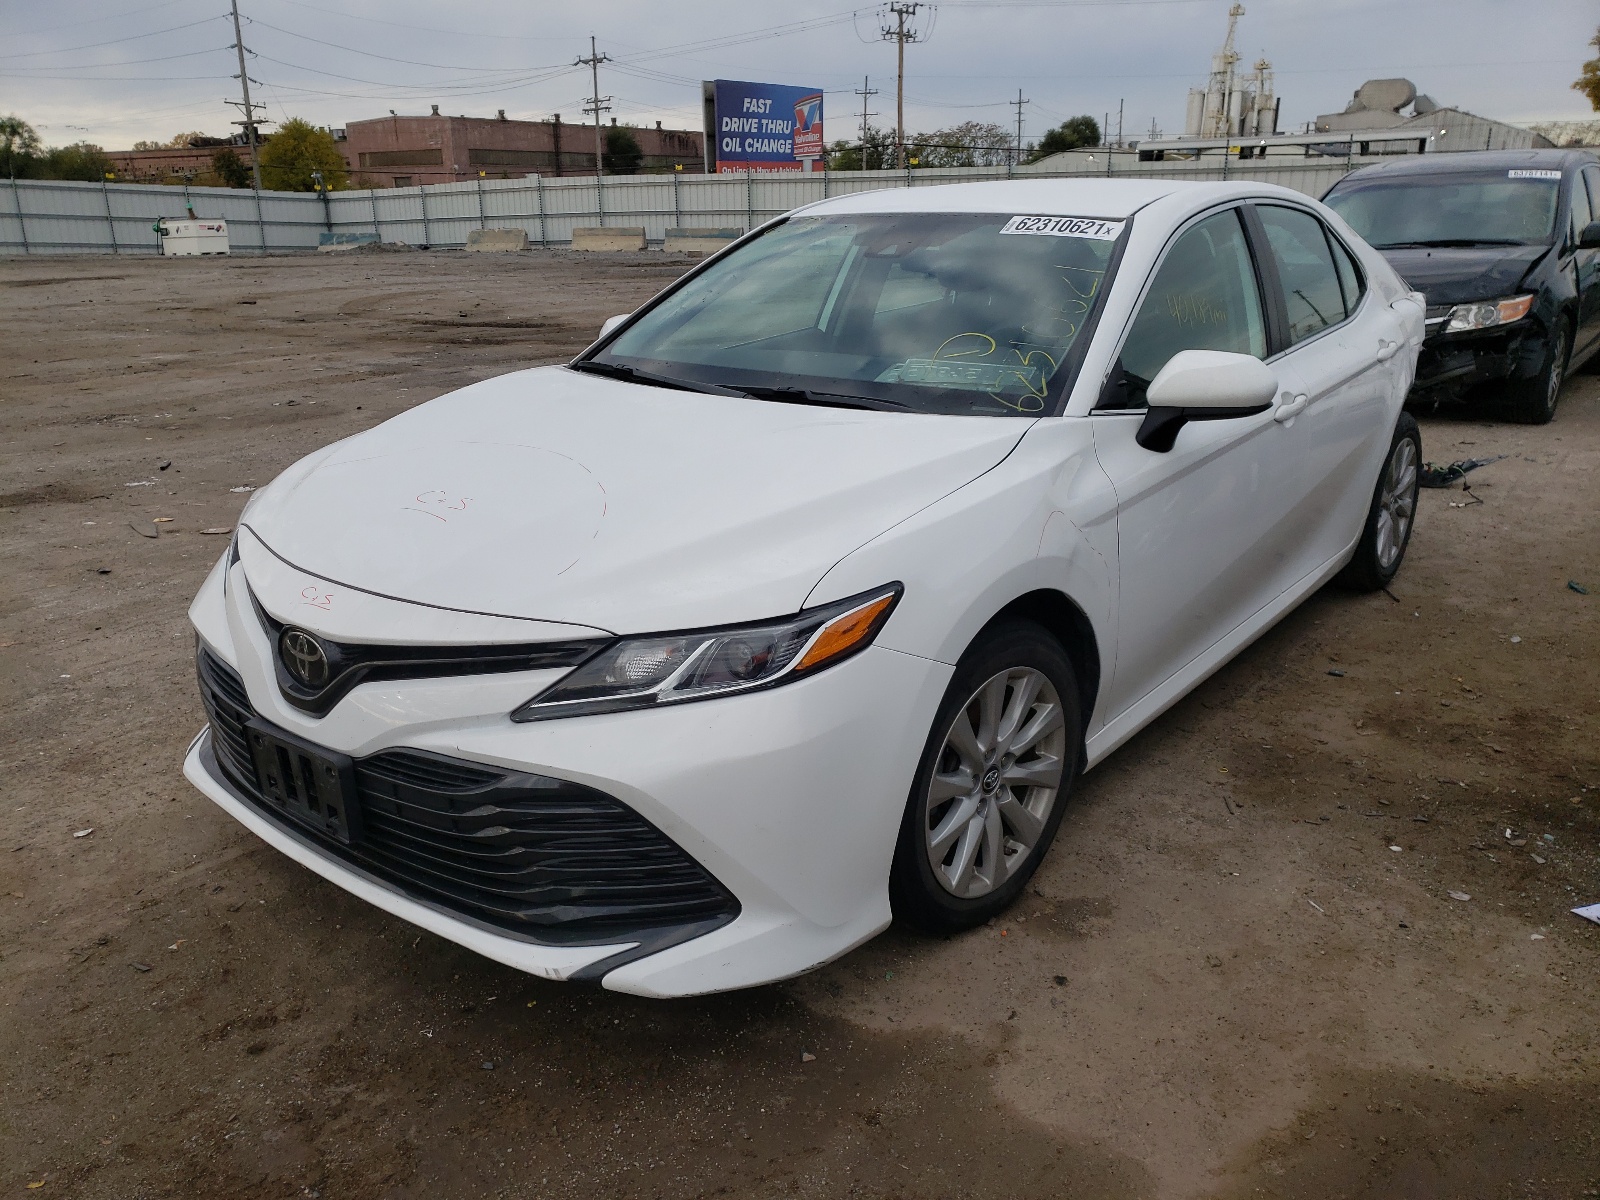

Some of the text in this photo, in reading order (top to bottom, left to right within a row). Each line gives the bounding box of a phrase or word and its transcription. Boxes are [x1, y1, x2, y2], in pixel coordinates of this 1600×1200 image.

[743, 97, 772, 114] FAST
[722, 117, 792, 134] DRIVE THRU
[722, 137, 792, 154] OIL CHANGE
